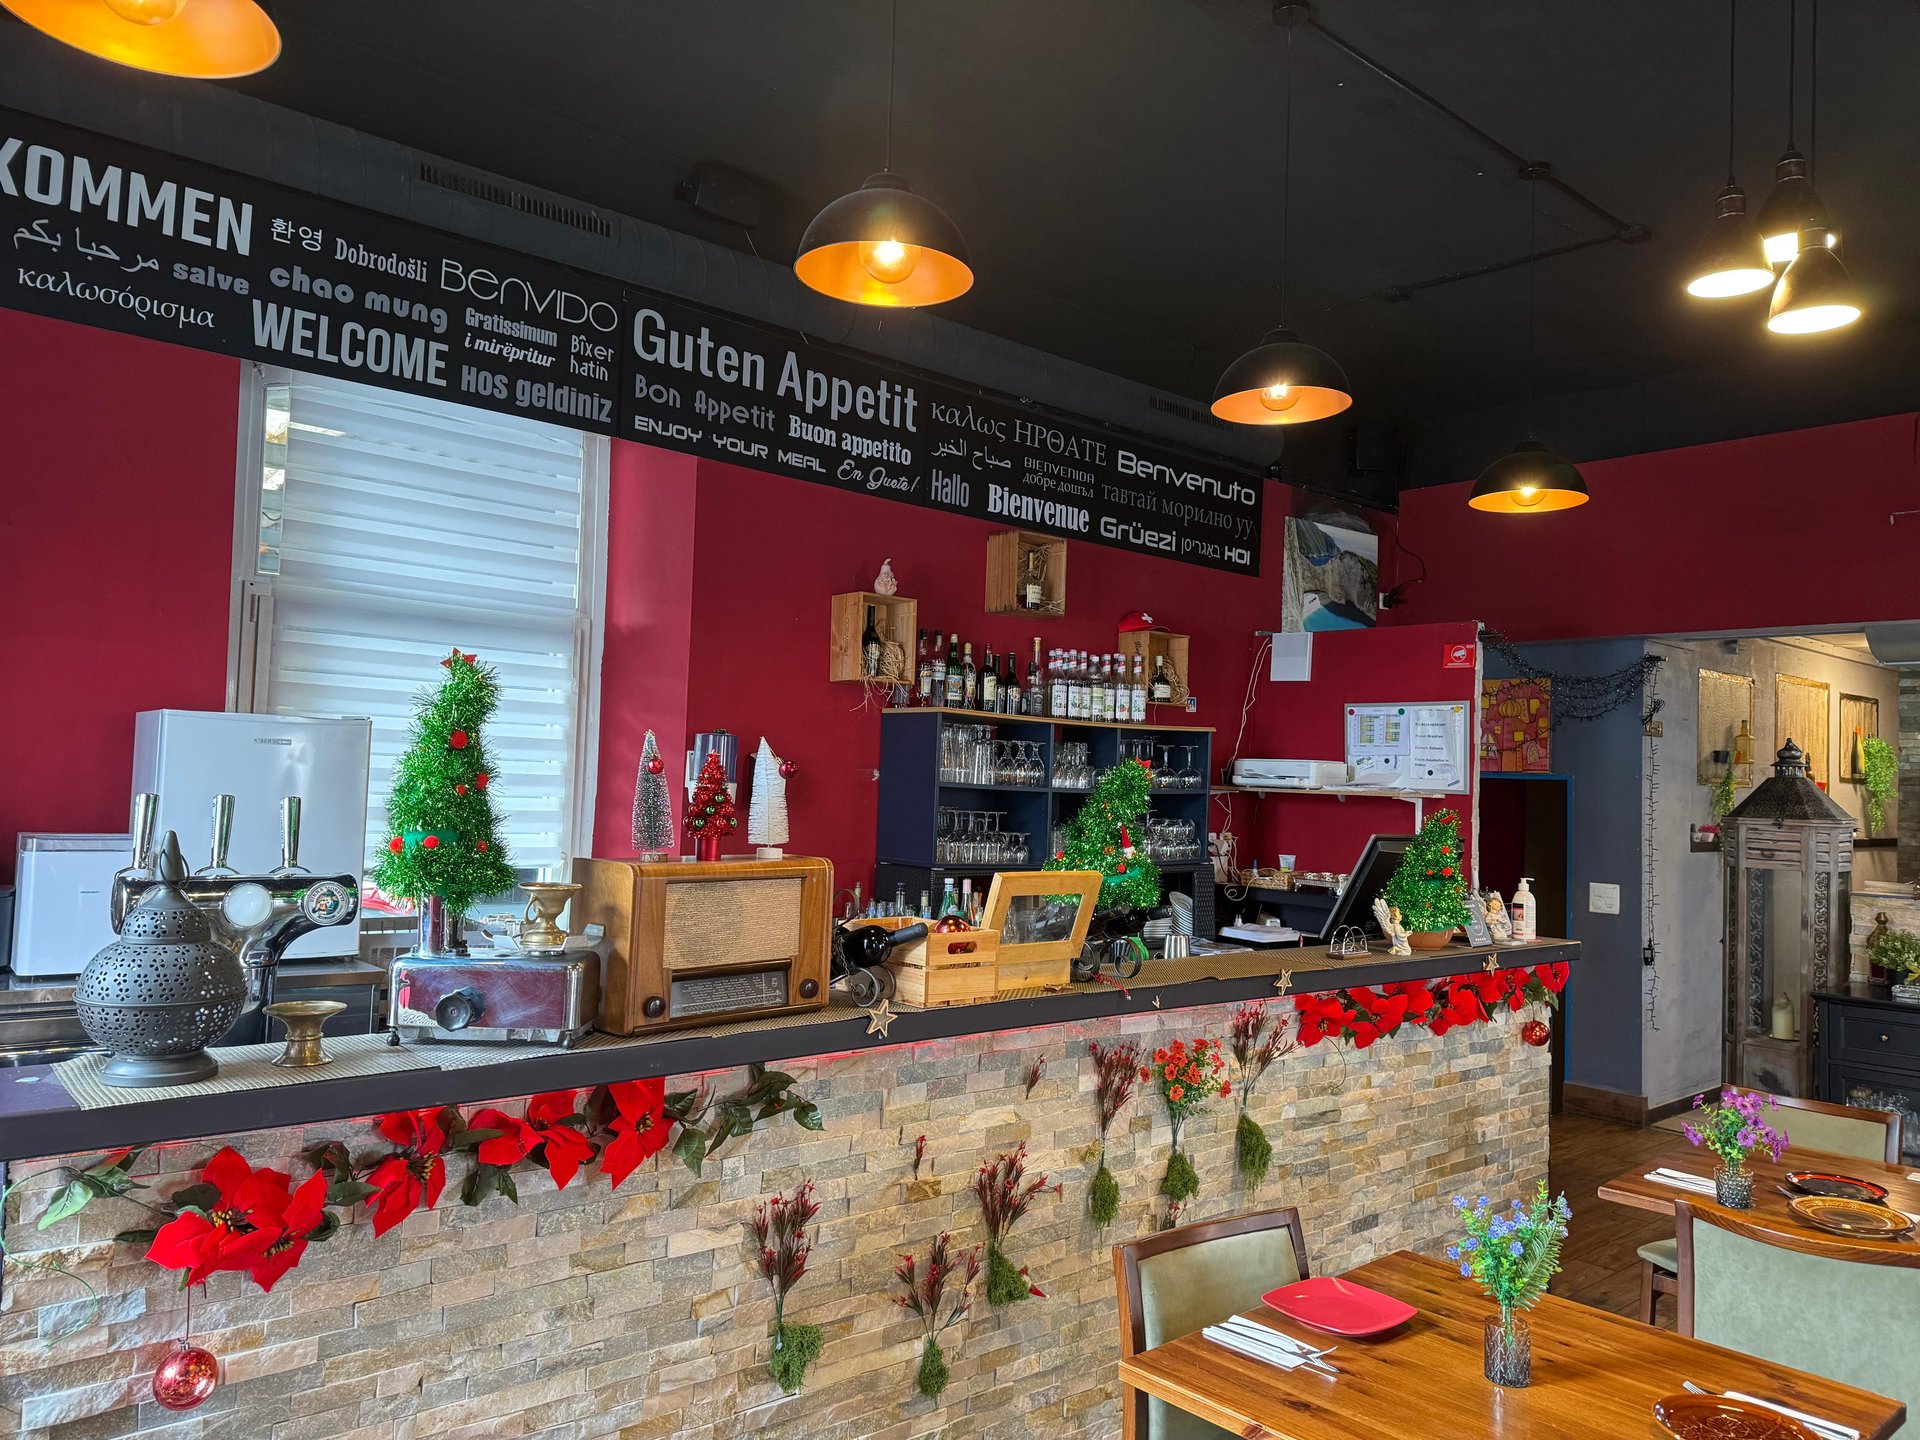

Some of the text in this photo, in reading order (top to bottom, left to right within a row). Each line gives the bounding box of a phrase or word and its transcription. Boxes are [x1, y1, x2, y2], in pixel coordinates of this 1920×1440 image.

[271, 218, 322, 251] 환영
[172, 263, 250, 295] salve
[334, 238, 428, 283] Dobrodošli
[17, 268, 215, 329] καλωσόρισμα
[270, 265, 449, 334] chao mung
[253, 299, 449, 387] WELCOME
[465, 307, 558, 348] Gratissimum
[464, 333, 556, 368] i mirëpritur
[570, 355, 609, 381] hatin
[571, 334, 615, 363] Bîxer
[633, 308, 918, 433] Guten Appetit
[515, 378, 612, 423] geldiniz
[635, 373, 775, 432] Bon Appetit
[788, 415, 912, 465] Buon appetito
[931, 402, 1006, 442] καλως
[634, 415, 826, 473] ENJOY YOUR MEAL
[837, 459, 864, 481] En
[931, 468, 970, 508] Hallo
[1022, 472, 1056, 492] добре
[1117, 450, 1255, 506] Benvenuto
[987, 483, 1090, 533] Bienvenue
[1101, 484, 1158, 512] тавтай
[1100, 516, 1177, 552] Grüezi
[1224, 545, 1251, 566] HOI
